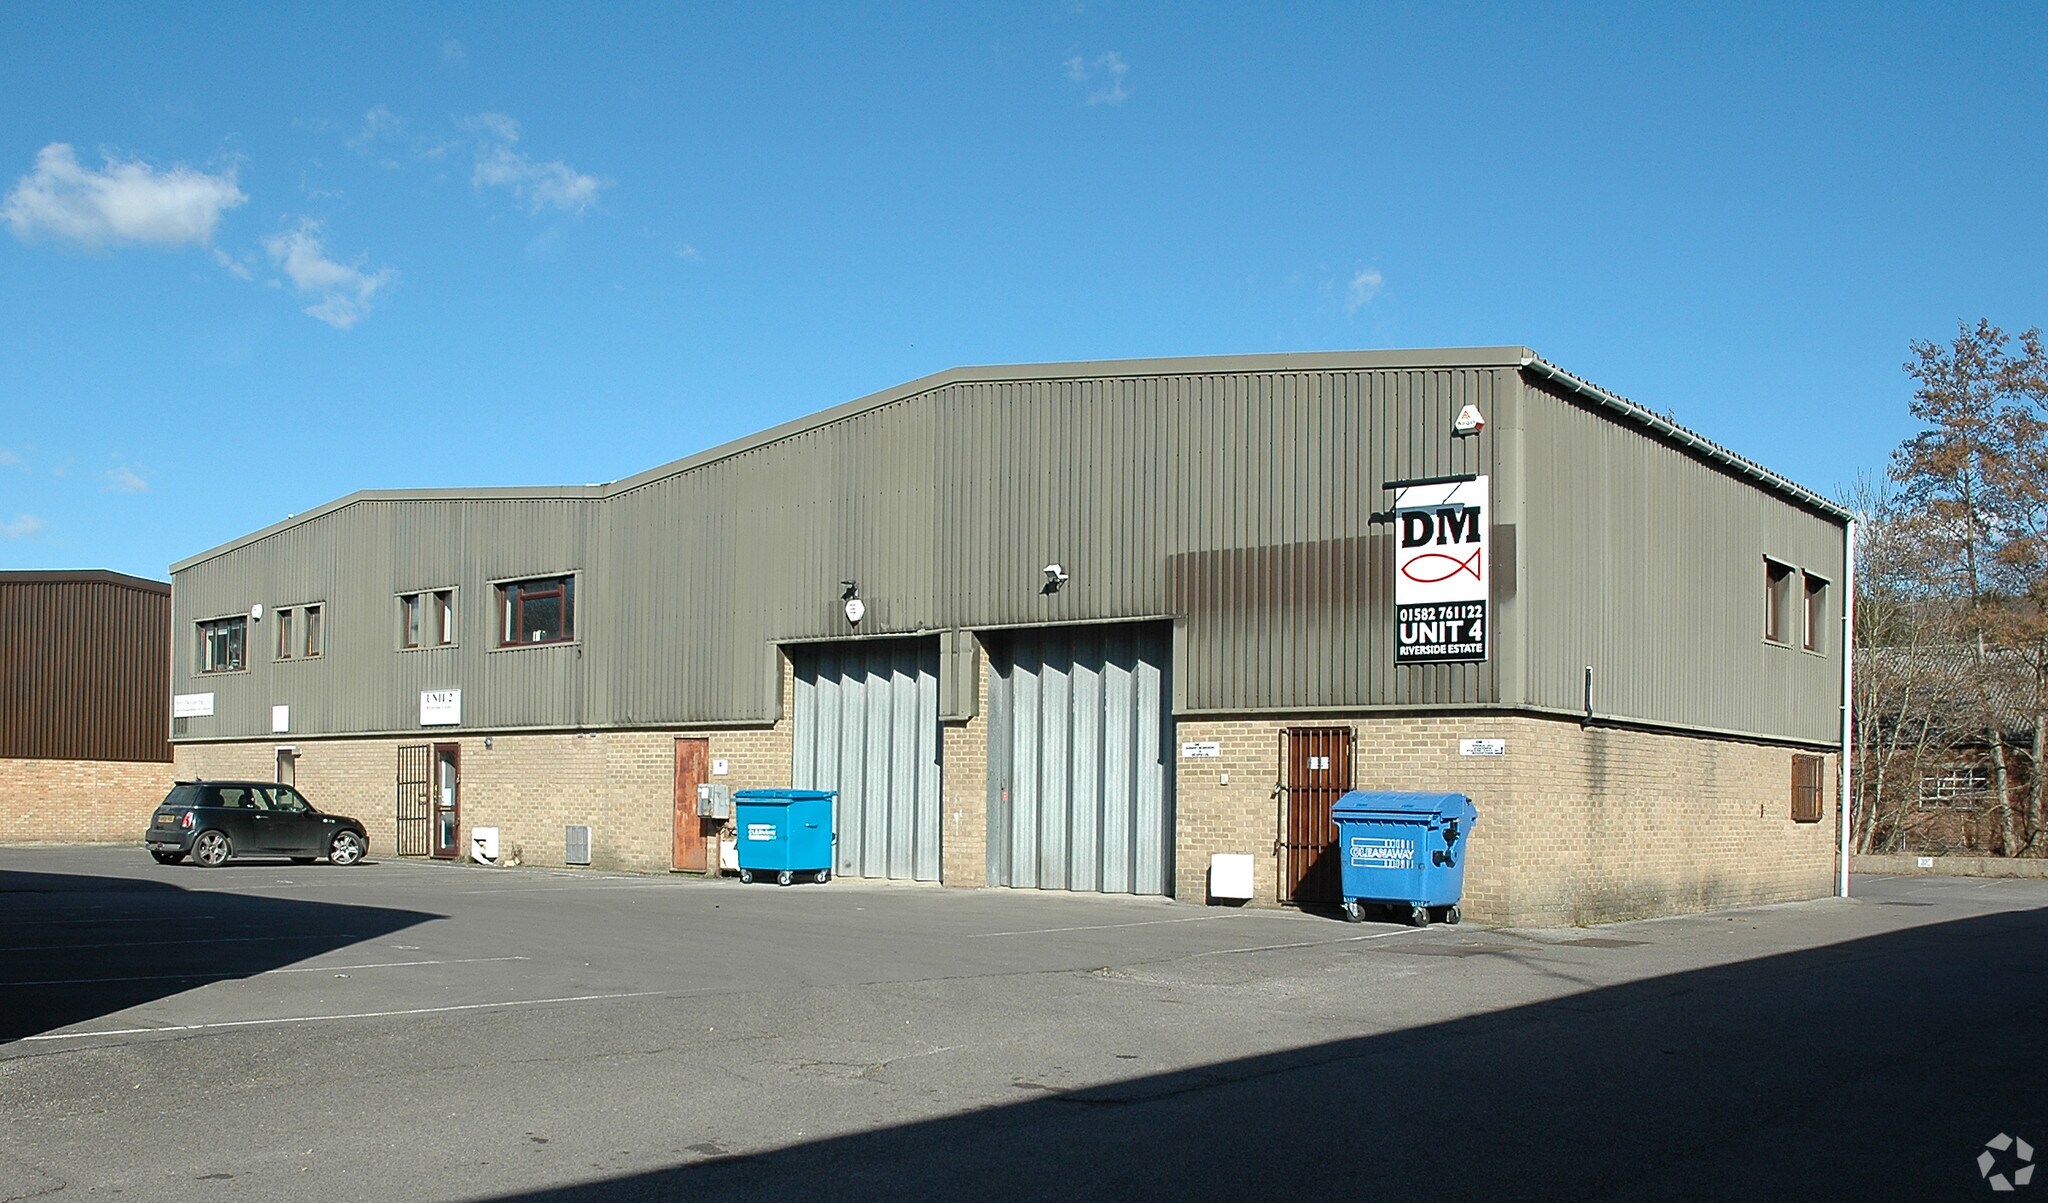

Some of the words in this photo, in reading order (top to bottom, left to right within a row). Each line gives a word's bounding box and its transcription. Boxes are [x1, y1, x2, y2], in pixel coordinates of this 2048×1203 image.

[1402, 506, 1481, 548] DM
[1400, 606, 1436, 622] 01582
[1438, 604, 1483, 620] 761122
[1400, 620, 1464, 645] UNIT
[1468, 619, 1483, 642] 4
[1400, 644, 1447, 656] RIVERSIDE
[1448, 643, 1483, 653] ESTATE
[1350, 847, 1414, 860] CLEANAWAY
